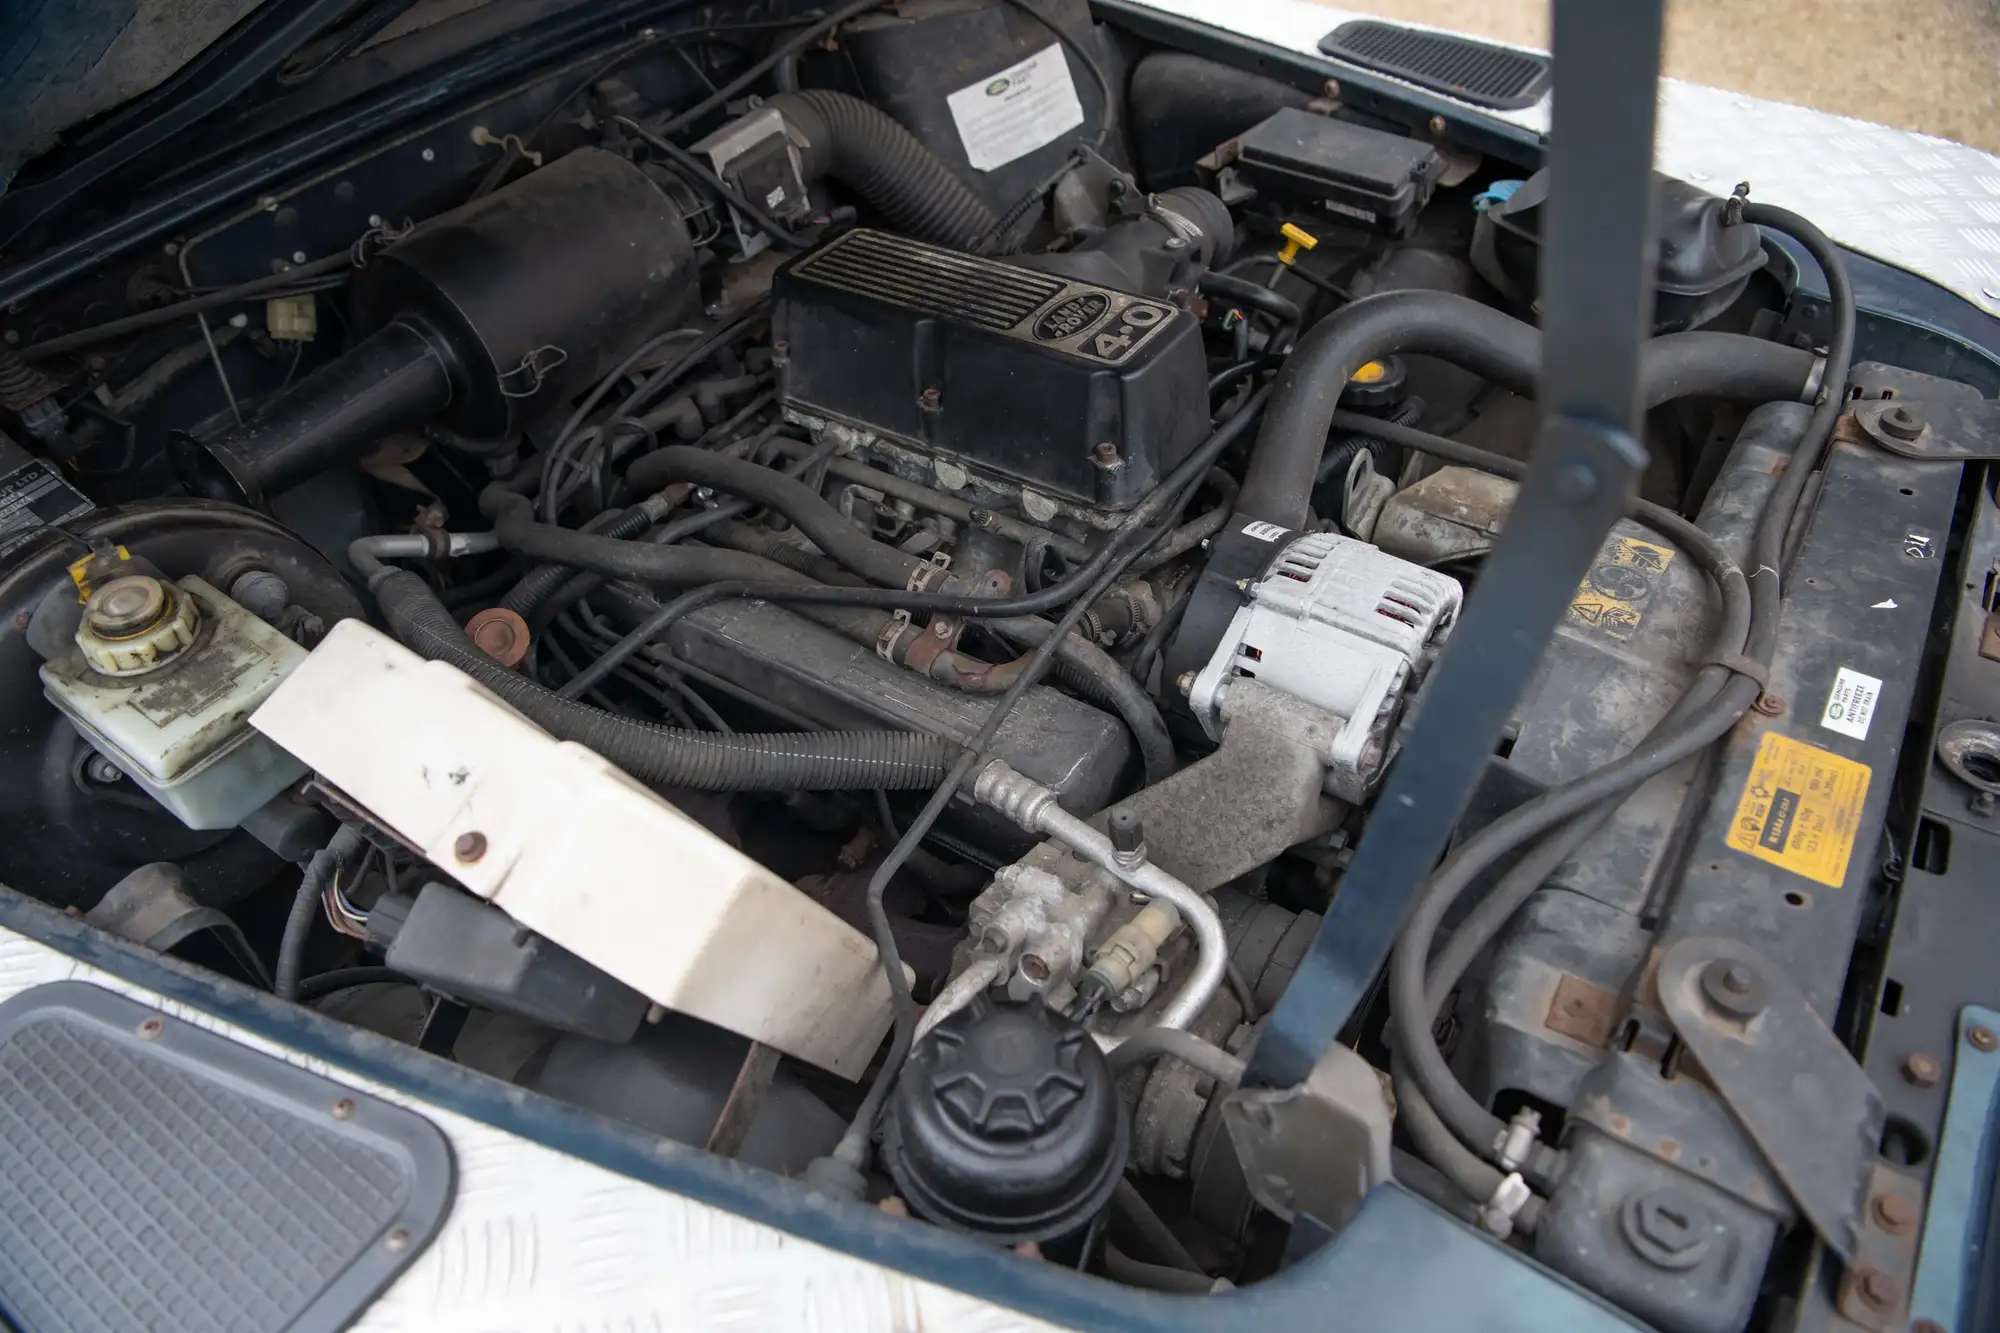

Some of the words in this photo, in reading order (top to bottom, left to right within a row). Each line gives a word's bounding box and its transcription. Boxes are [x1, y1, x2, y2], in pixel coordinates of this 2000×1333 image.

[1043, 300, 1082, 330] LAND
[1058, 299, 1105, 334] ROVER
[1846, 685, 1866, 724] ANTIFREEZE
